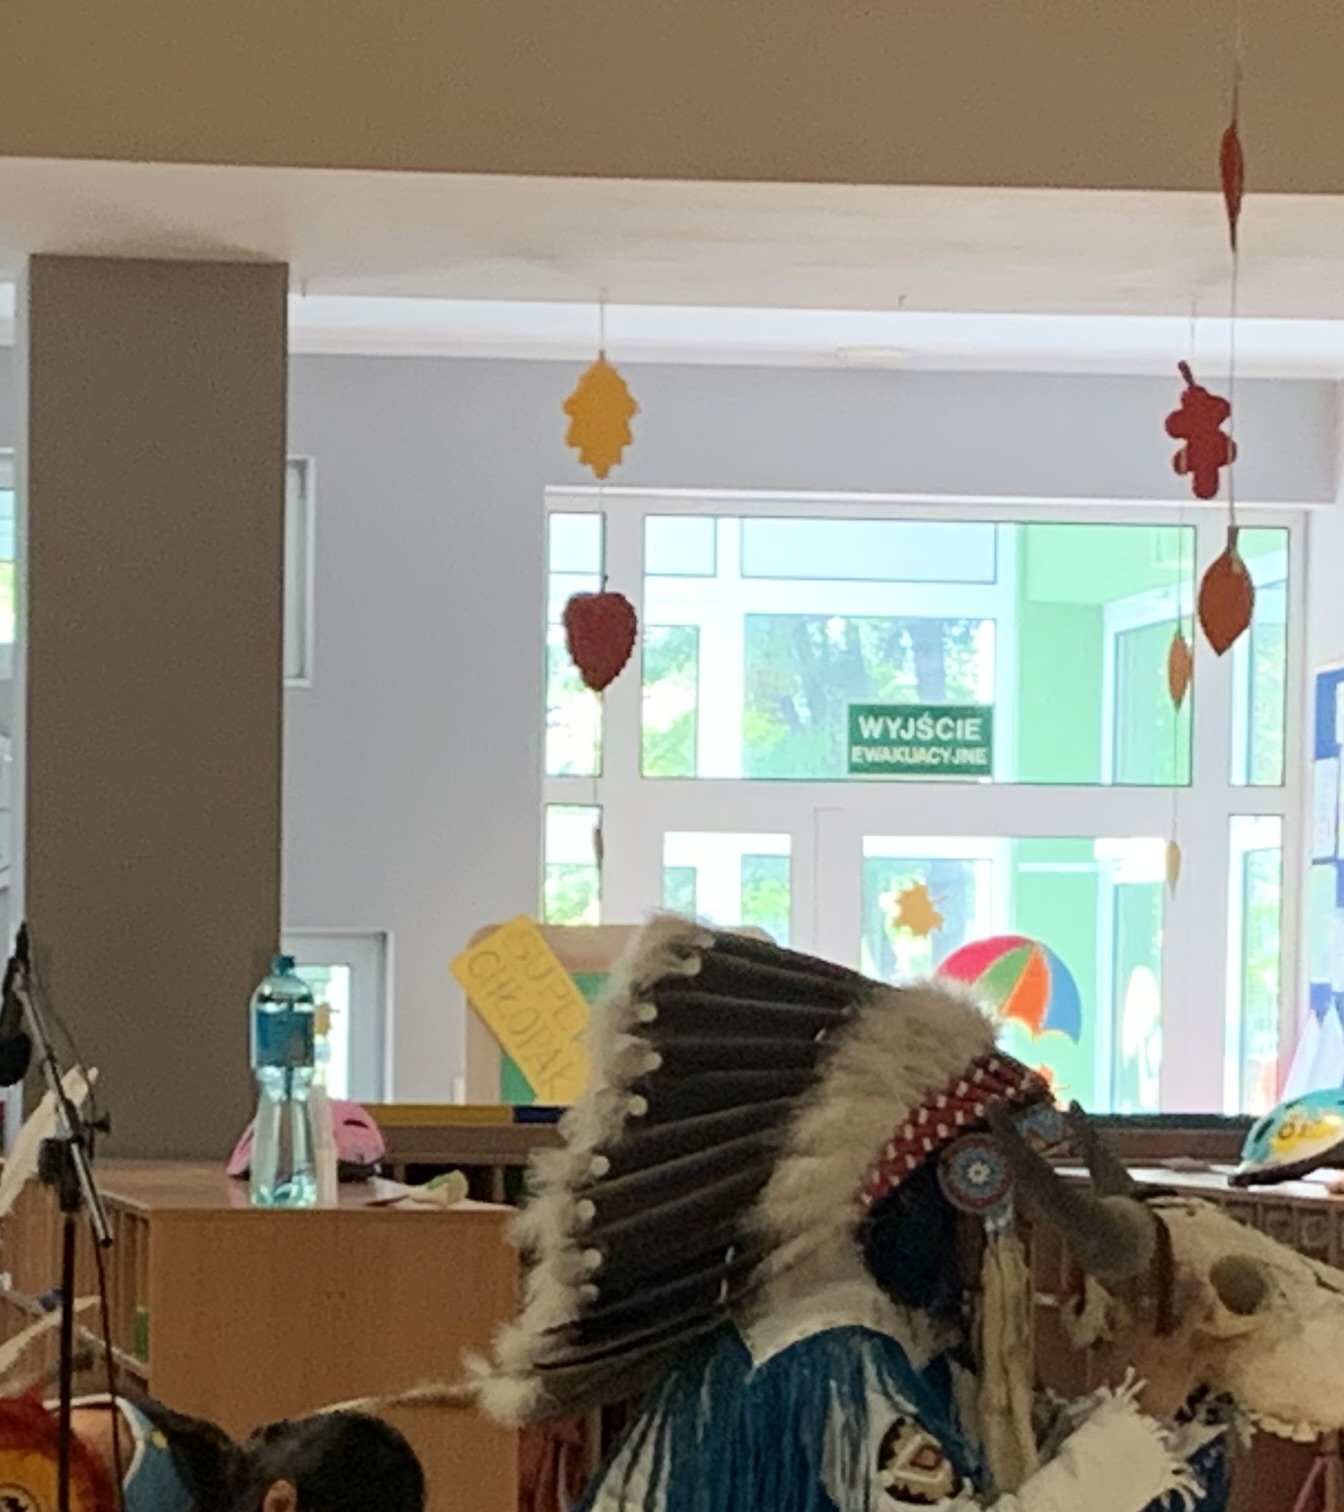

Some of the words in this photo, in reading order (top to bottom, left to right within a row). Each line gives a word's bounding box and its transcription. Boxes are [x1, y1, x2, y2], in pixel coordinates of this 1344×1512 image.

[857, 711, 983, 741] WYJŚCIE
[850, 745, 988, 765] EWAKUACYJNE
[515, 929, 584, 1044] SUPE
